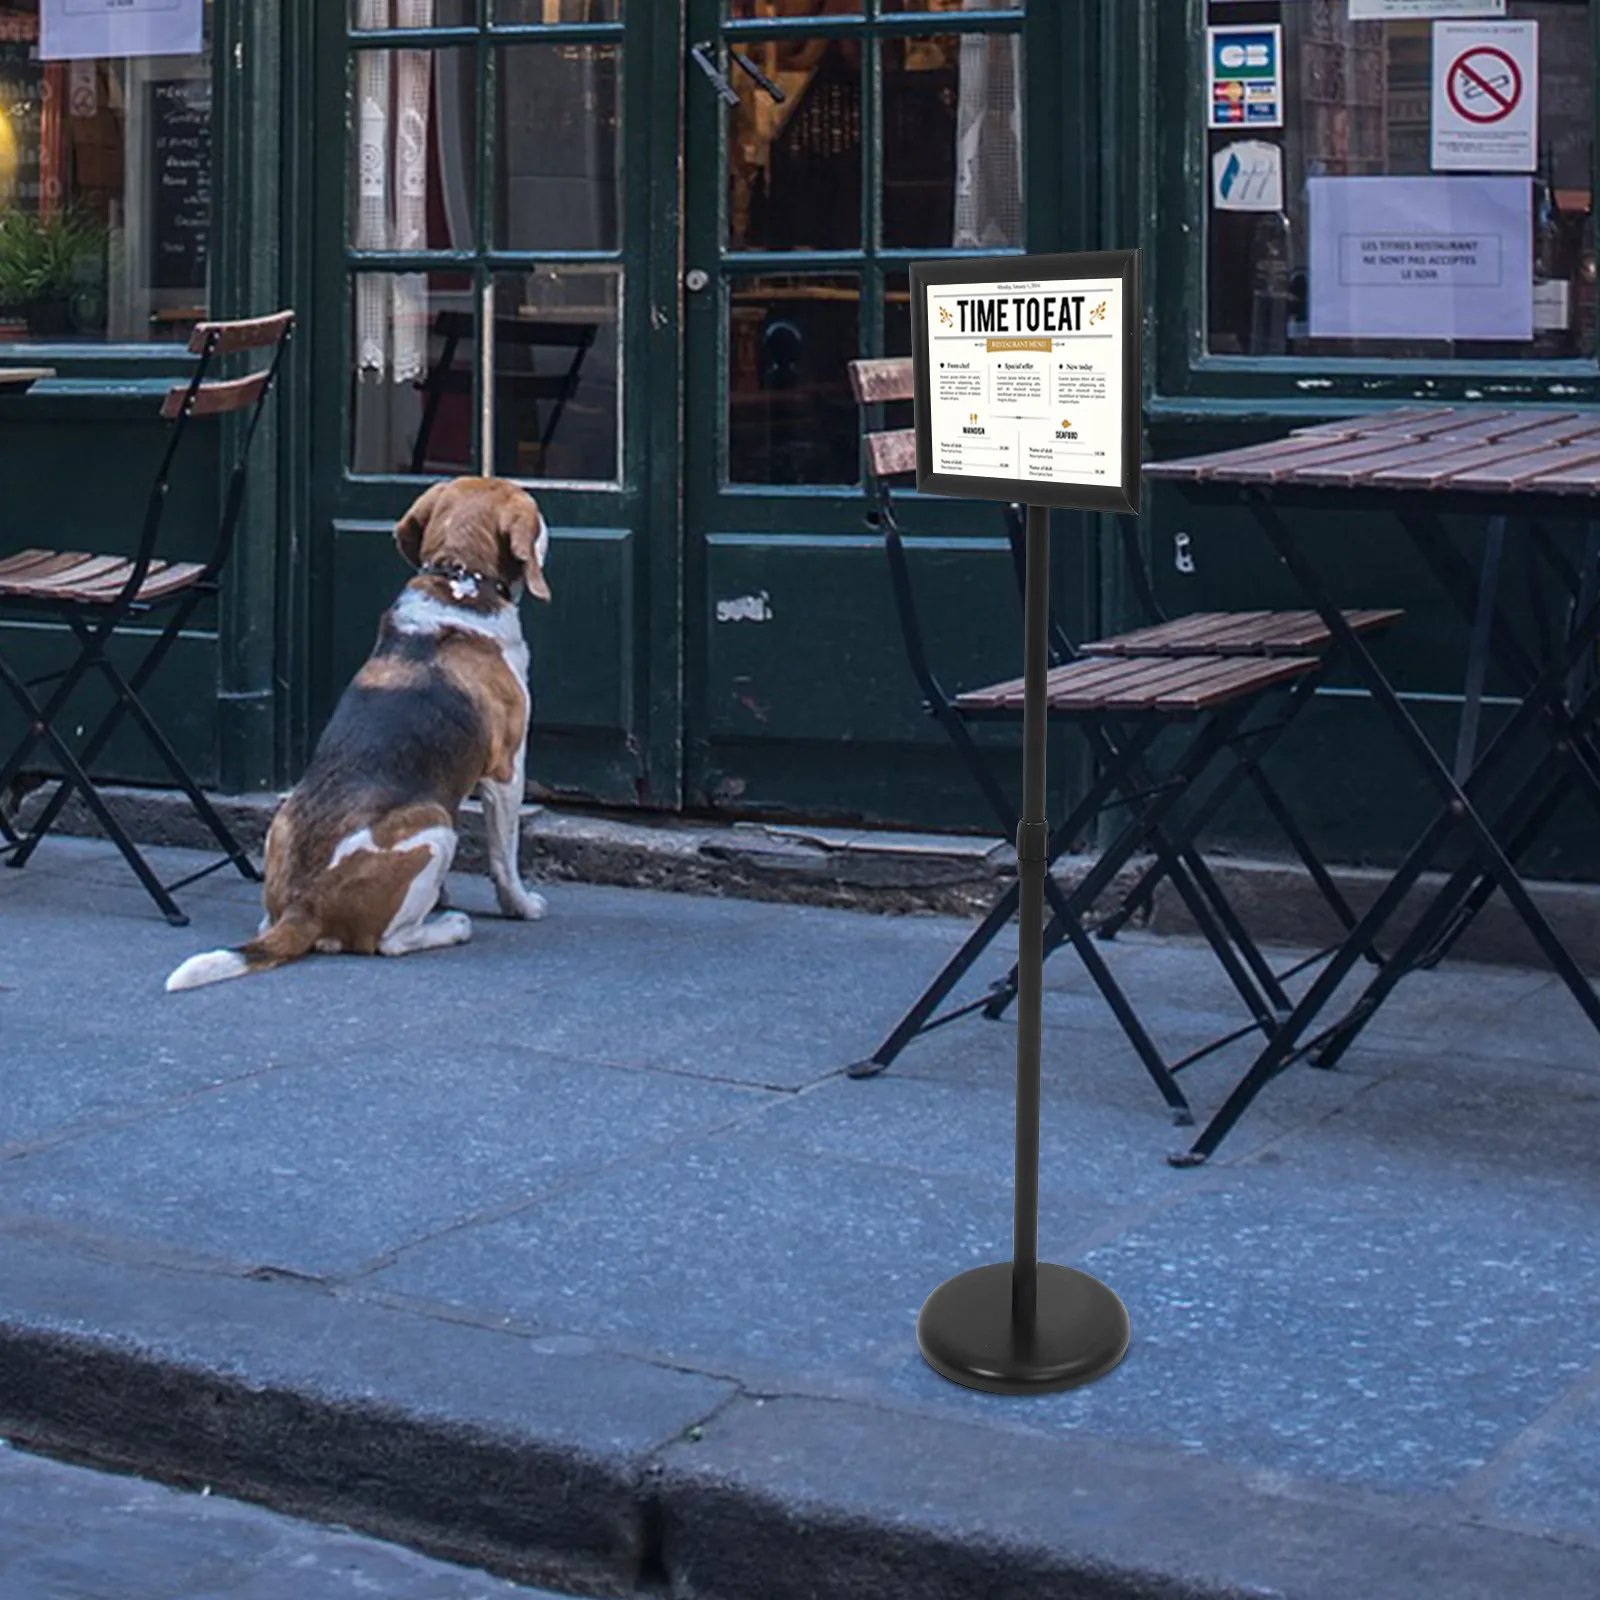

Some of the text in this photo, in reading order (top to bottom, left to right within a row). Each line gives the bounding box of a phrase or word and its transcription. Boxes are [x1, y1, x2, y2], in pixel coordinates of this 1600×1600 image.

[1220, 45, 1269, 67] CB
[1362, 241, 1478, 251] LES TITRES RESTAURANT
[1363, 255, 1376, 265] NE
[1380, 255, 1405, 265] SONT
[1408, 255, 1426, 265] PAS
[1401, 269, 1438, 279] LE SOIR
[957, 296, 1085, 332] TIME TO EAT
[991, 341, 1047, 349] RESTAURANT MENU
[1005, 362, 1033, 370] Special offer
[1056, 430, 1079, 440] SEAFOOD
